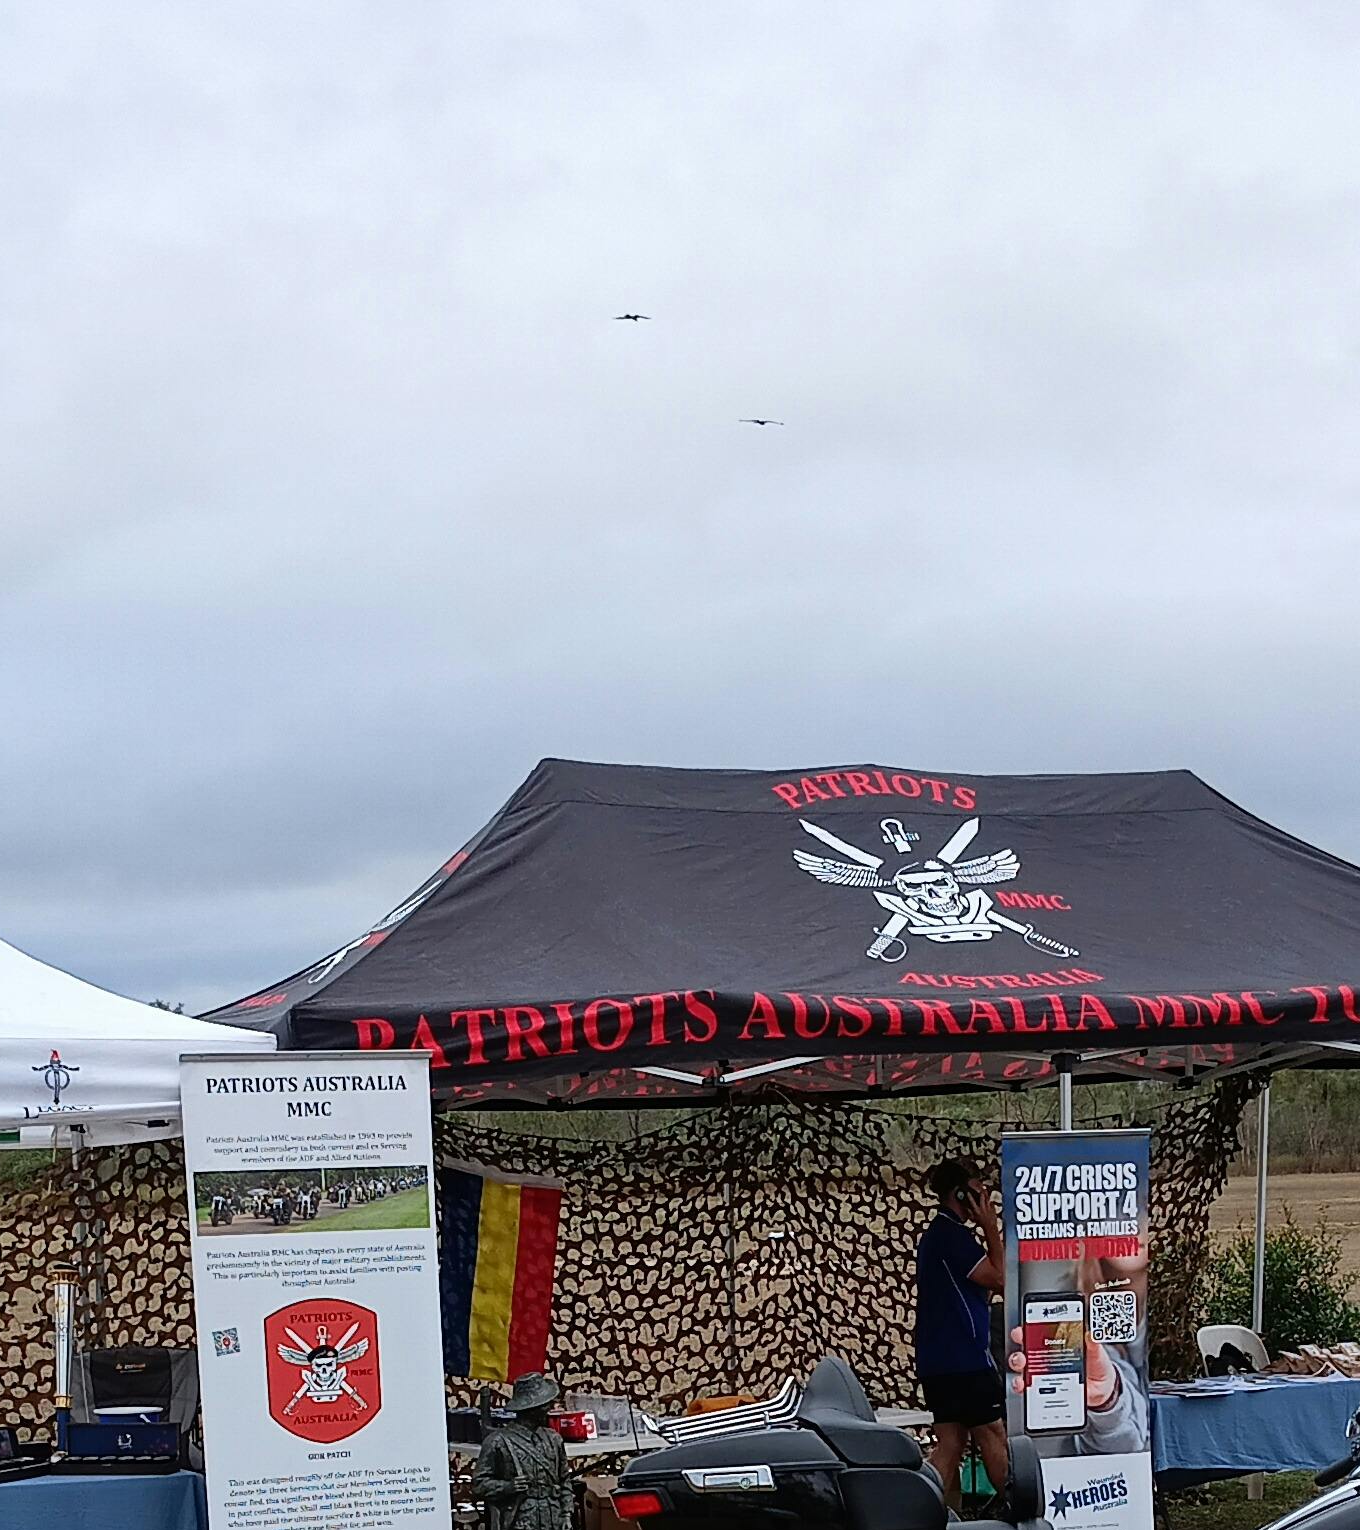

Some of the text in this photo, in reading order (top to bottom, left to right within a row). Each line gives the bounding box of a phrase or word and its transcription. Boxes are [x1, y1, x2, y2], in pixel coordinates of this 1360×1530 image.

[772, 771, 977, 810] PATRIOTS
[996, 891, 1072, 911] MMC
[898, 968, 1105, 989] AUSTRALIA
[352, 989, 719, 1069] PATRIOTS
[738, 991, 1119, 1040] AUSTRALIA
[1128, 990, 1286, 1029] MMC
[206, 1075, 407, 1093] PATRIOTS AUSTRALIA
[287, 1101, 332, 1117] MMC
[1015, 1163, 1137, 1193] 24/7 CRISIS
[1015, 1190, 1138, 1223] SUPPORT 4
[1016, 1220, 1139, 1239] VETERANS & FAMILIES
[289, 1311, 353, 1324] PATRIOTS
[293, 1412, 359, 1425] AUSTRALIA
[1071, 1479, 1128, 1509] HEROES
